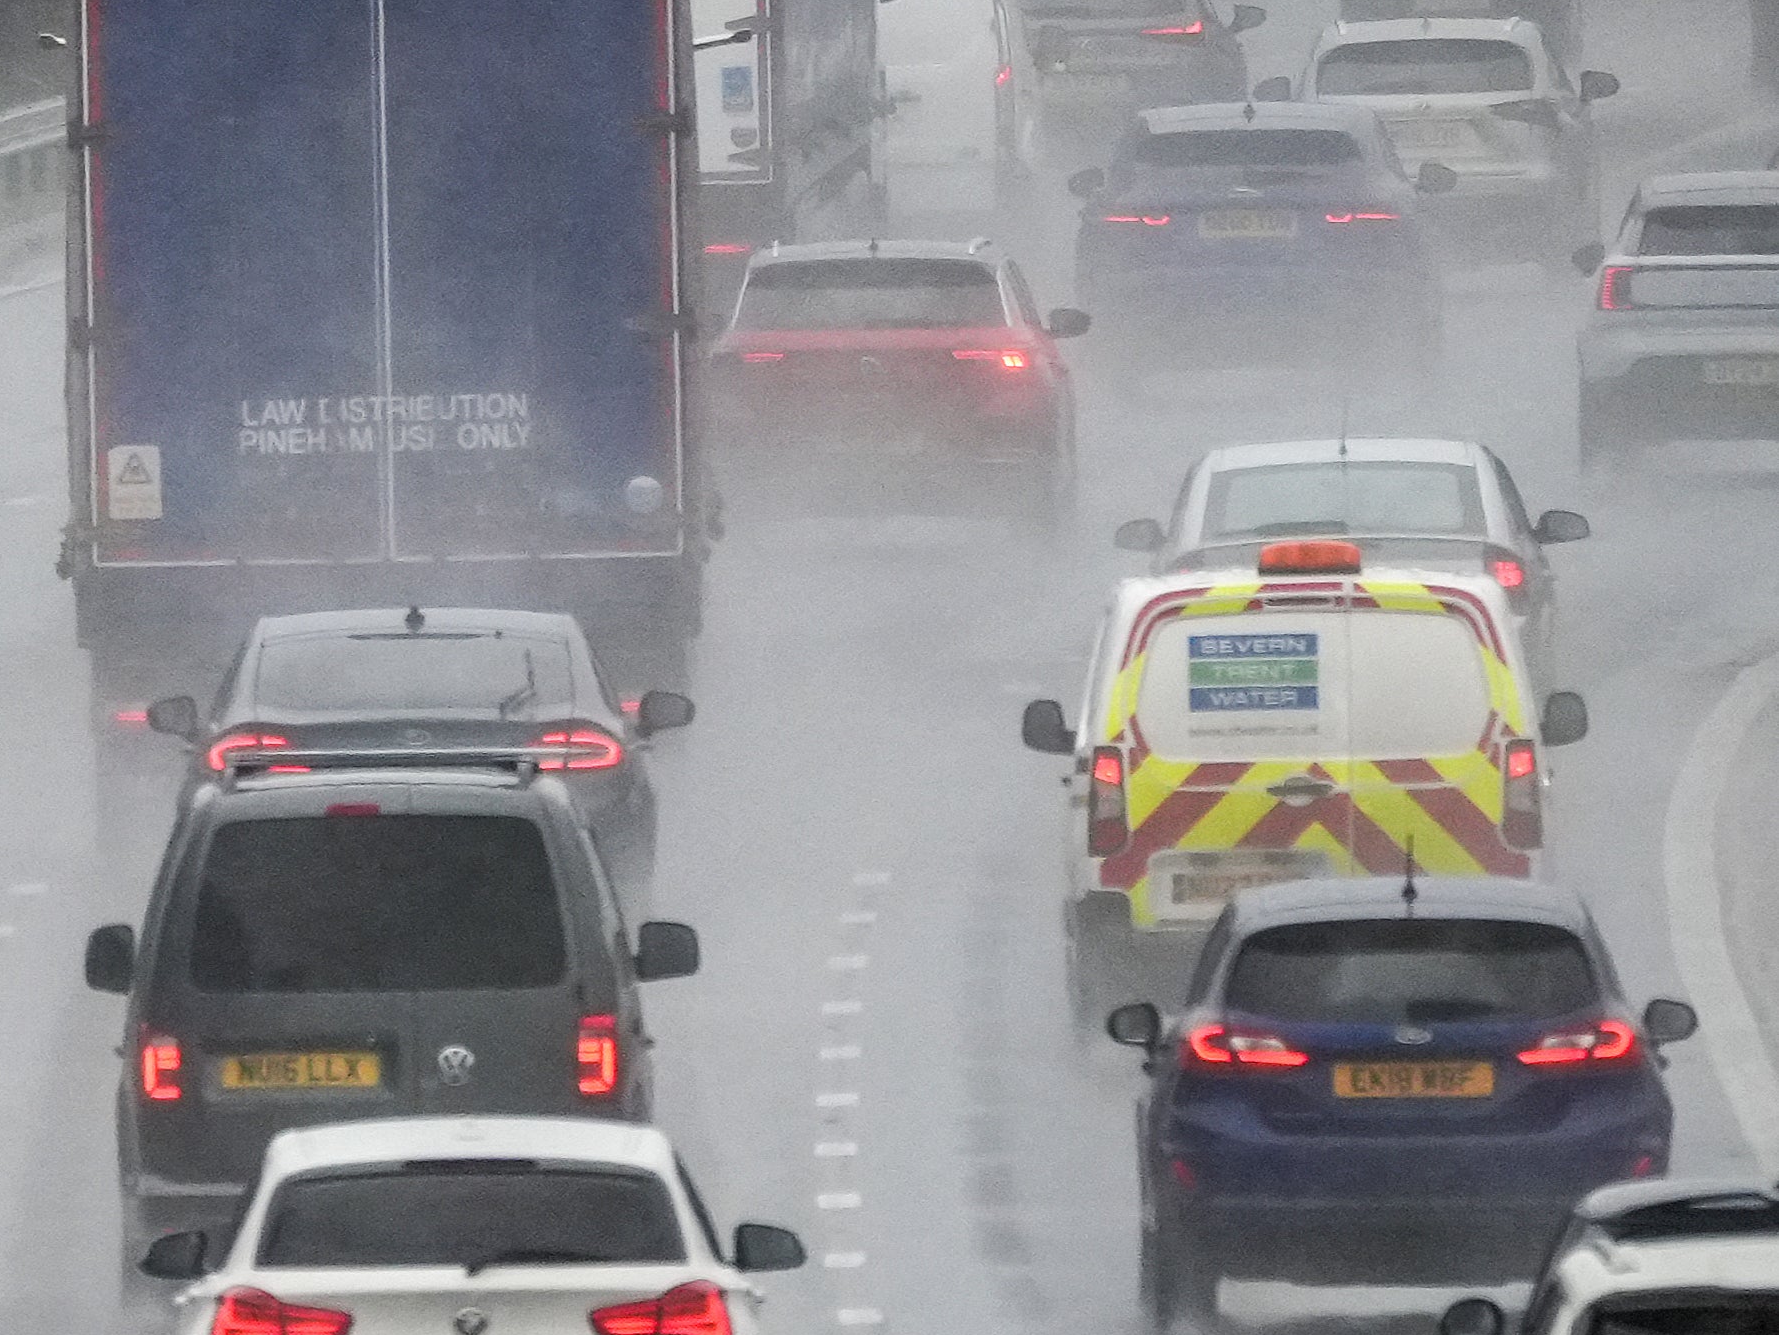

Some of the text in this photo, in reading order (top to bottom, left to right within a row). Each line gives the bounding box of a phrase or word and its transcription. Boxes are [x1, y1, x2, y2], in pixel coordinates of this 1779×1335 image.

[241, 398, 306, 427] LAW
[457, 421, 531, 450] ONLY
[1201, 639, 1307, 654] SEVERN
[1214, 664, 1296, 679] TRENT
[1208, 690, 1298, 706] WATER
